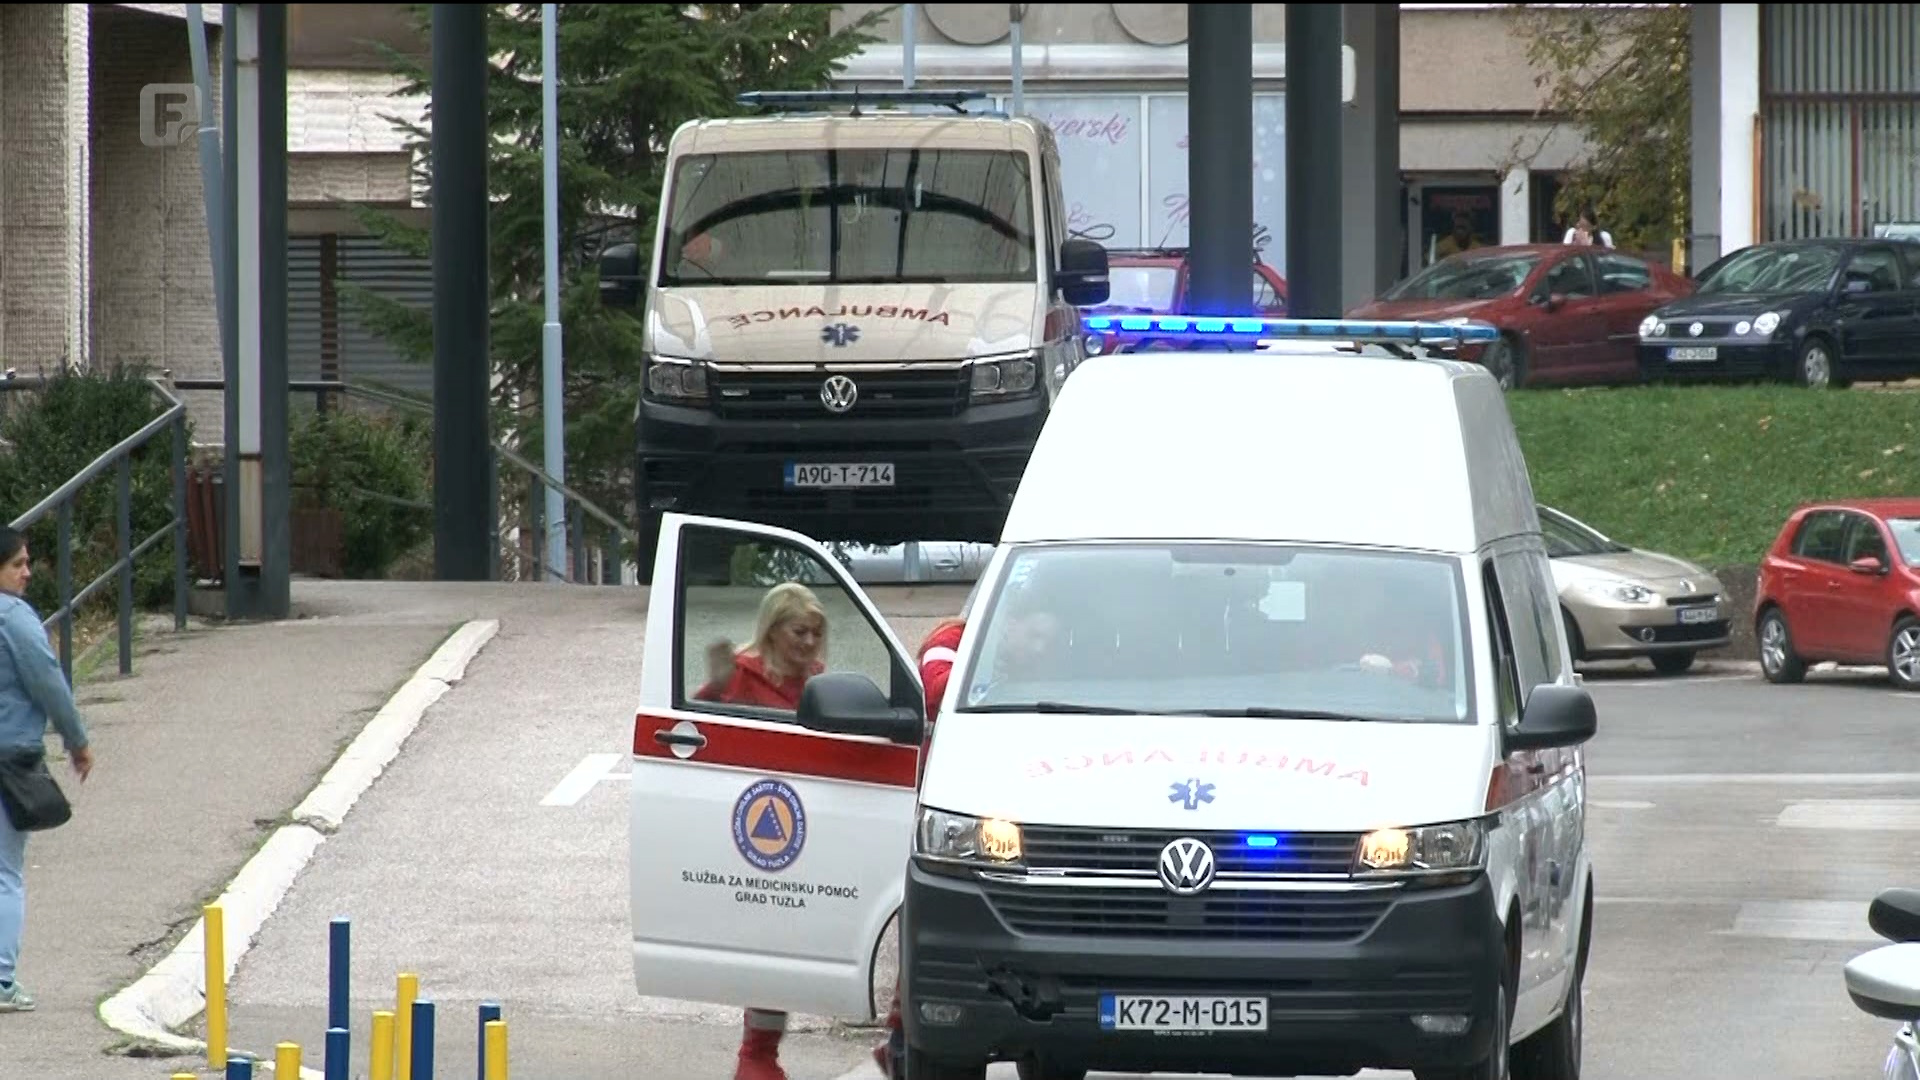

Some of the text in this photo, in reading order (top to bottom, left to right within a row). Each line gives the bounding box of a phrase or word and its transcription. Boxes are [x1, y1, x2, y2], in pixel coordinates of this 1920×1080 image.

[797, 465, 892, 484] A90-T-714
[682, 870, 860, 900] SLUŽBA ZA MEDICINSKU POMOĆ
[735, 891, 806, 908] GRAD TUZLA
[1119, 999, 1262, 1026] K72-M-015
